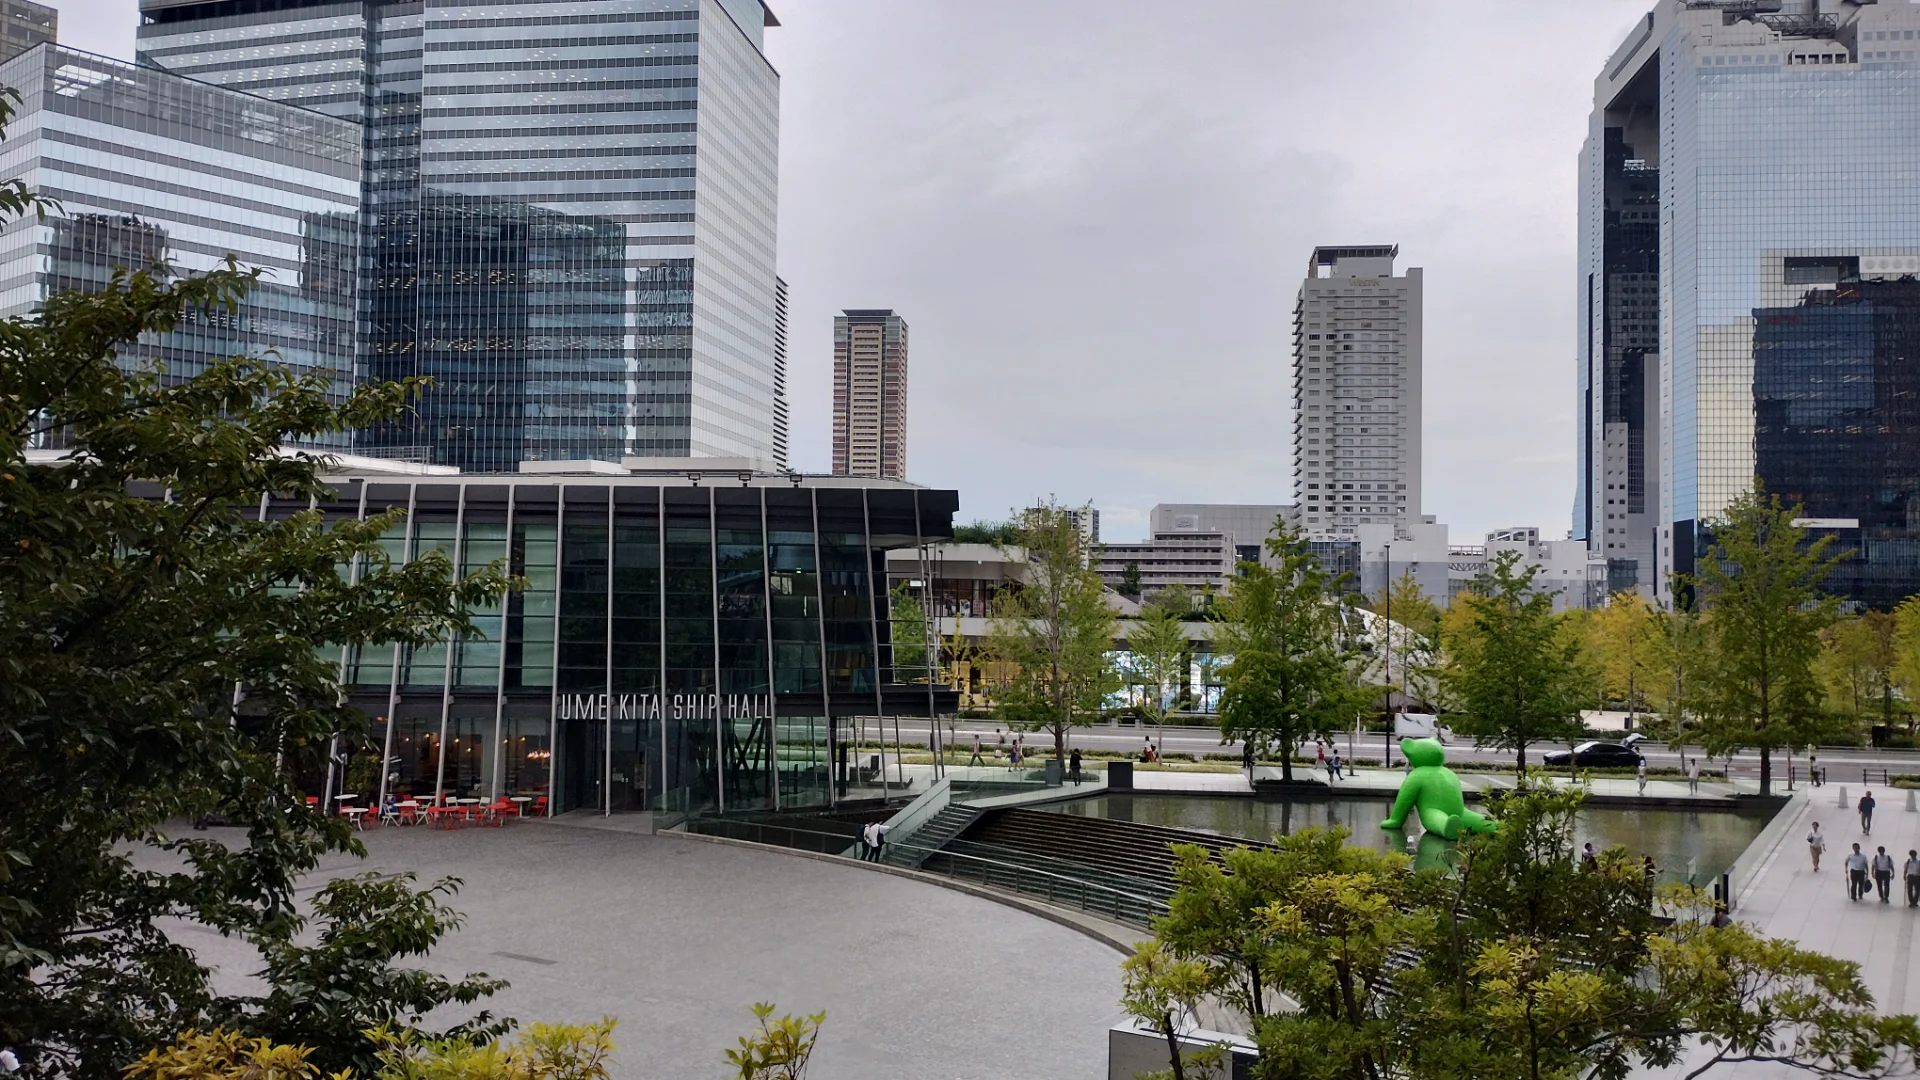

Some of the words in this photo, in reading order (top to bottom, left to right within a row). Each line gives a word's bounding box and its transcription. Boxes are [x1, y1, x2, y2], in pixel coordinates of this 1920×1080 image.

[561, 693, 608, 720] UME
[619, 693, 661, 720] KITA
[673, 693, 718, 720] SHIP
[728, 693, 773, 719] HALL
